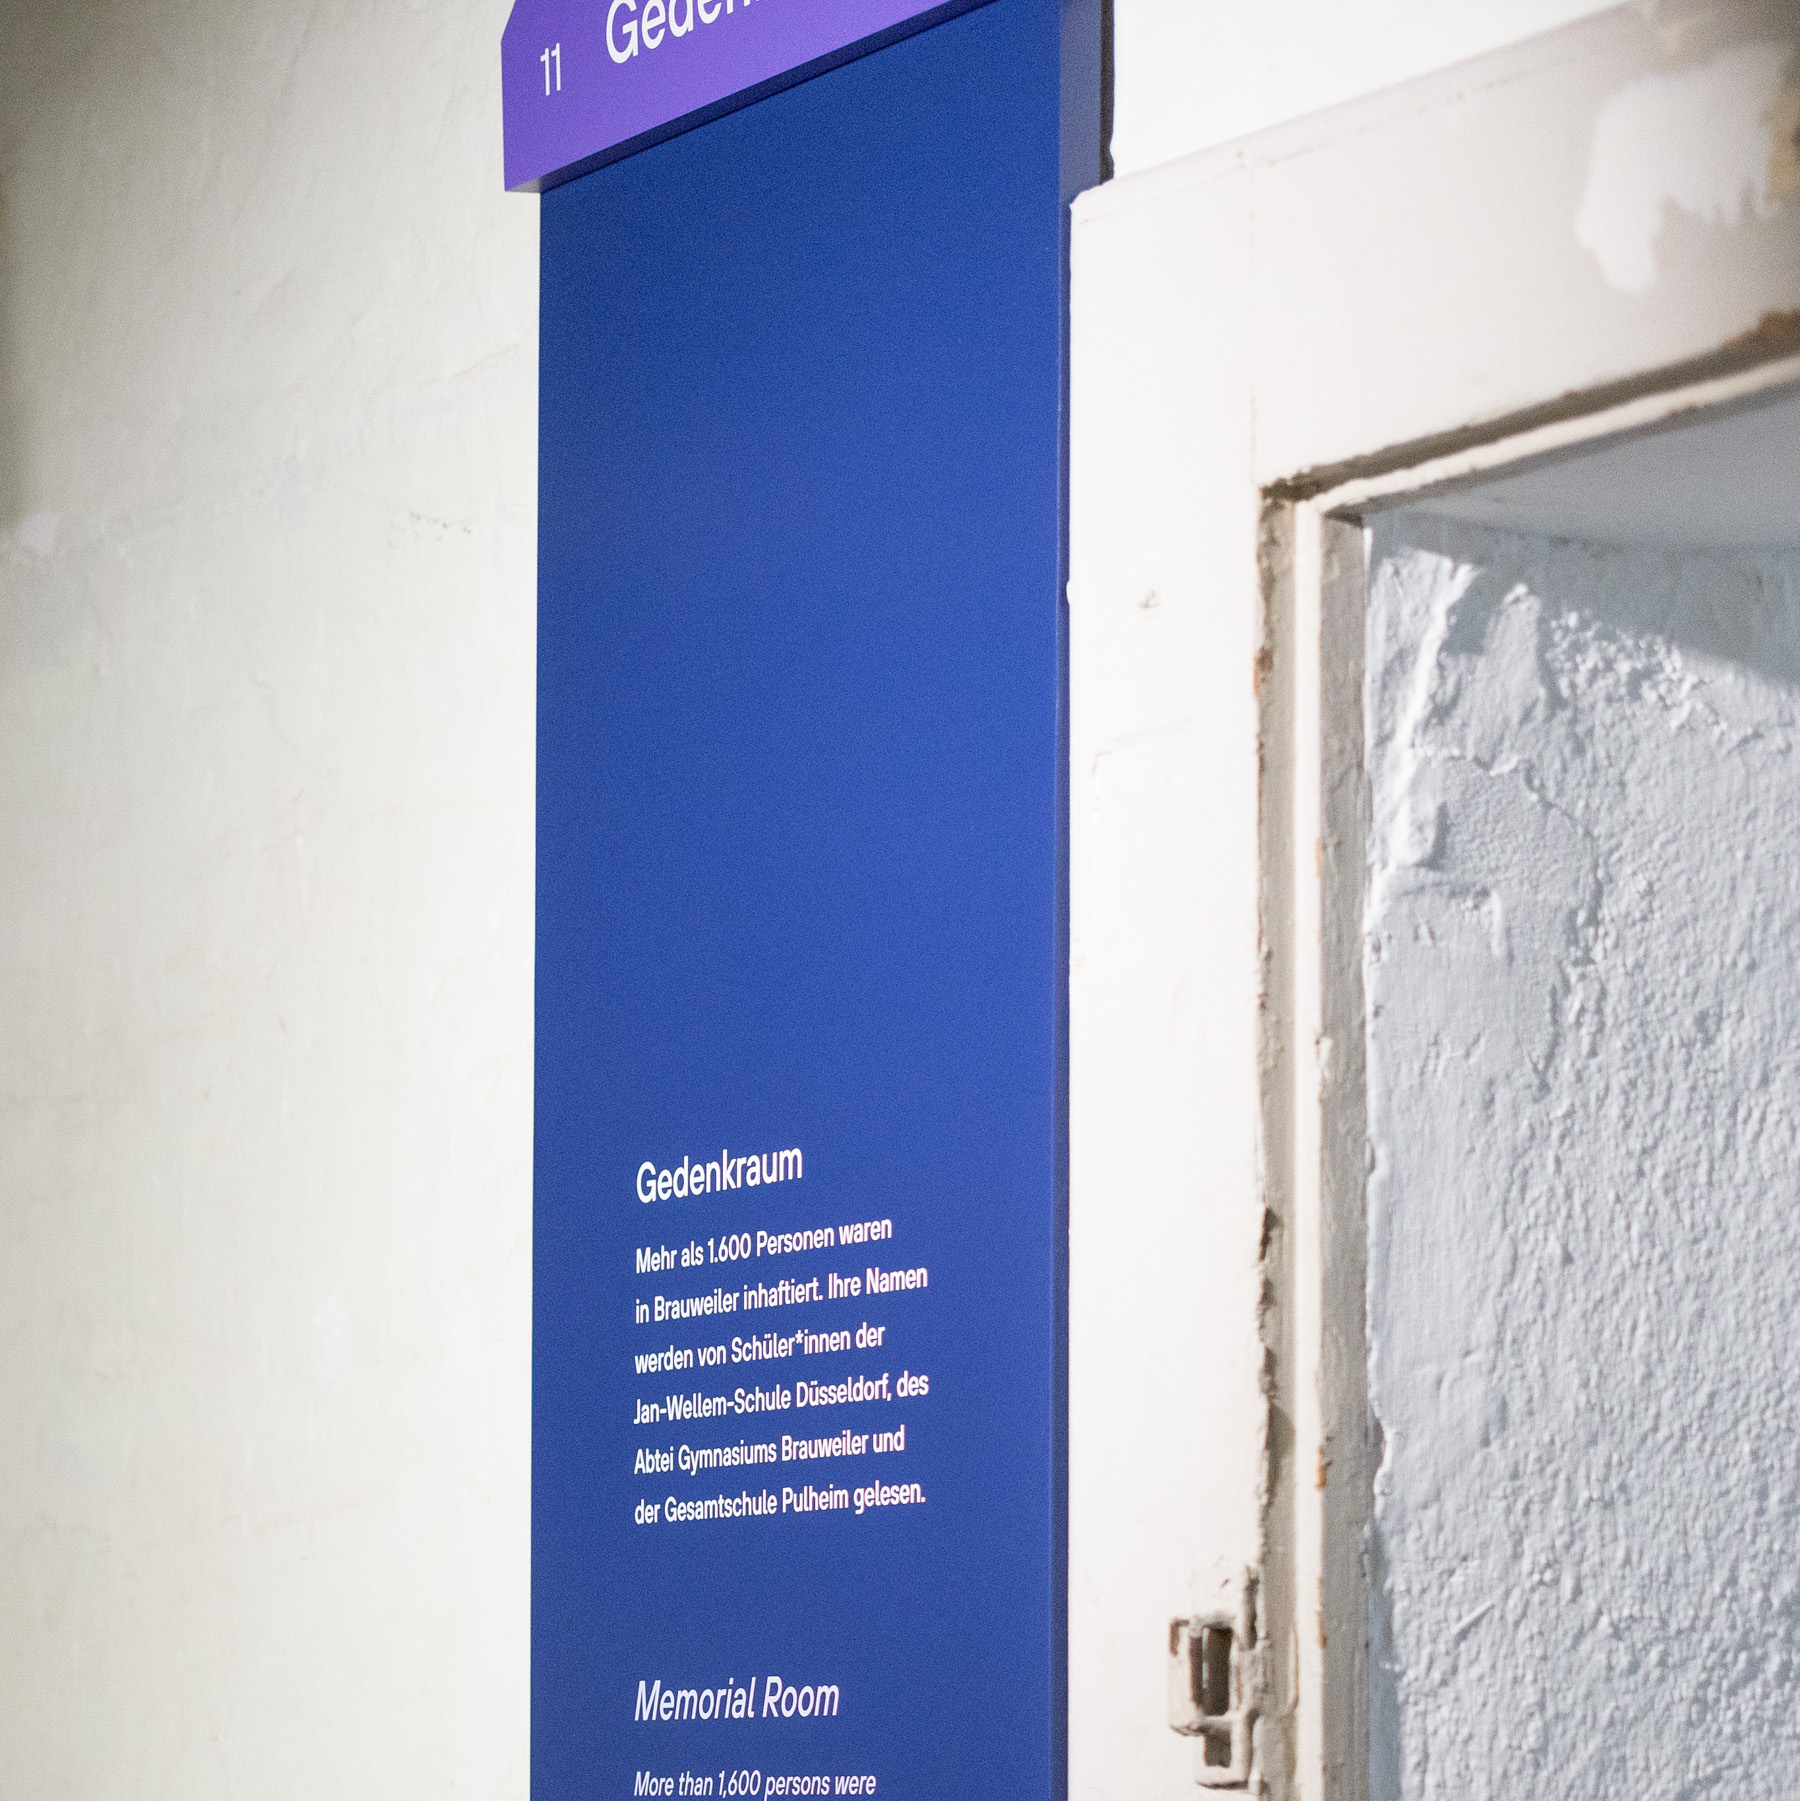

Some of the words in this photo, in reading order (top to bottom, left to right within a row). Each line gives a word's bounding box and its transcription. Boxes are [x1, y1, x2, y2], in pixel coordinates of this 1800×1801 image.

[539, 42, 561, 97] 11
[636, 1148, 803, 1203] Gedenkraum
[636, 1245, 678, 1274] Mehr
[681, 1241, 704, 1268] als
[707, 1232, 752, 1263] 1.600
[756, 1227, 835, 1257] Personen
[838, 1219, 893, 1245] waren
[635, 1299, 650, 1324] in
[654, 1288, 740, 1322] Brauweiler
[743, 1277, 824, 1310] inhaftiert.
[828, 1272, 862, 1299] Ihre
[866, 1267, 928, 1295] Namen
[634, 1345, 694, 1374] werden
[697, 1345, 727, 1367] von
[855, 1321, 886, 1349] der
[633, 1384, 792, 1424] Jan-Wellem-Schule
[796, 1372, 892, 1408] Düsseldorf,
[896, 1370, 930, 1398] des
[634, 1446, 674, 1474] Abtei
[678, 1440, 777, 1476] Gymnasiums
[781, 1429, 869, 1462] Brauweiler
[872, 1424, 906, 1453] und
[634, 1499, 661, 1525] der
[664, 1489, 778, 1522] Gesamtschule
[782, 1484, 849, 1513] Pulheim
[853, 1480, 926, 1515] gelesen.
[634, 1676, 757, 1721] Memorial
[762, 1675, 840, 1718] Room
[633, 1771, 675, 1797] More
[678, 1771, 714, 1796] than
[718, 1769, 762, 1798] 1,600
[763, 1775, 831, 1801] persons
[834, 1775, 877, 1795] were
